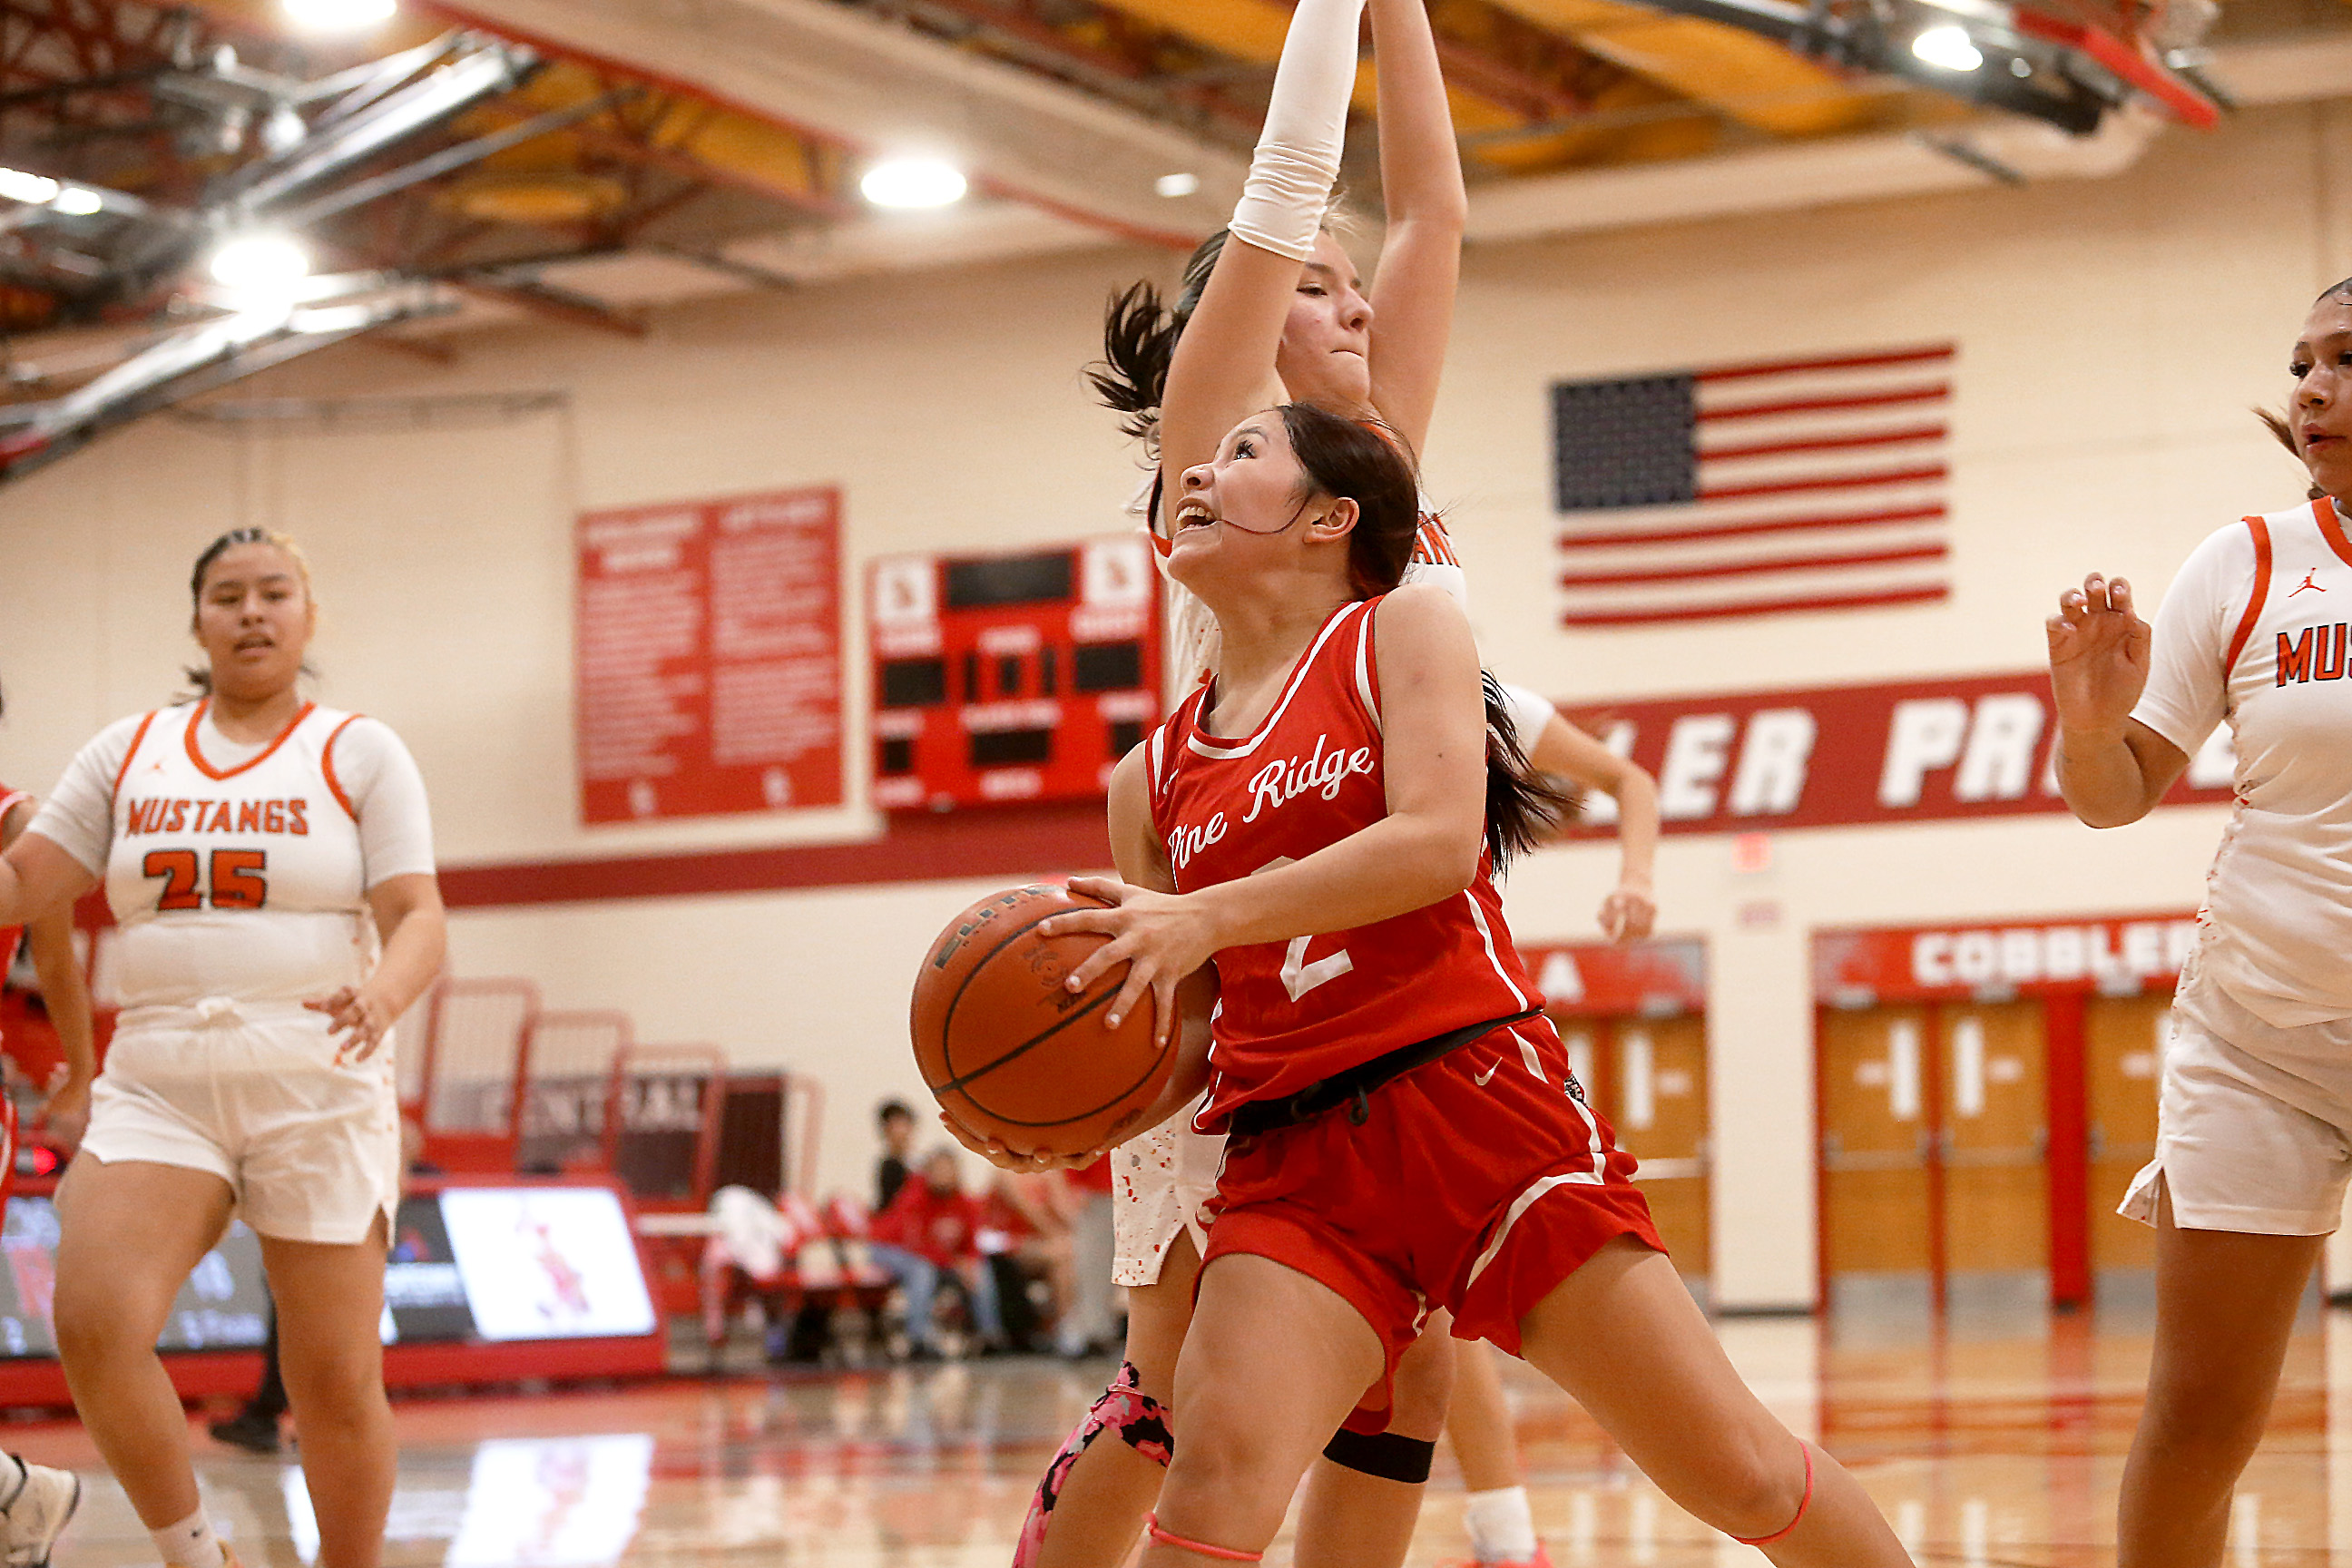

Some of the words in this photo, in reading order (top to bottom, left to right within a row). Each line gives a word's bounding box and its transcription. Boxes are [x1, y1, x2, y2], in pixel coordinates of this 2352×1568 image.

[2276, 622, 2352, 688] MU
[1242, 733, 1375, 823] Ridge
[125, 799, 309, 840] MUSTANGS
[142, 848, 268, 912] 25
